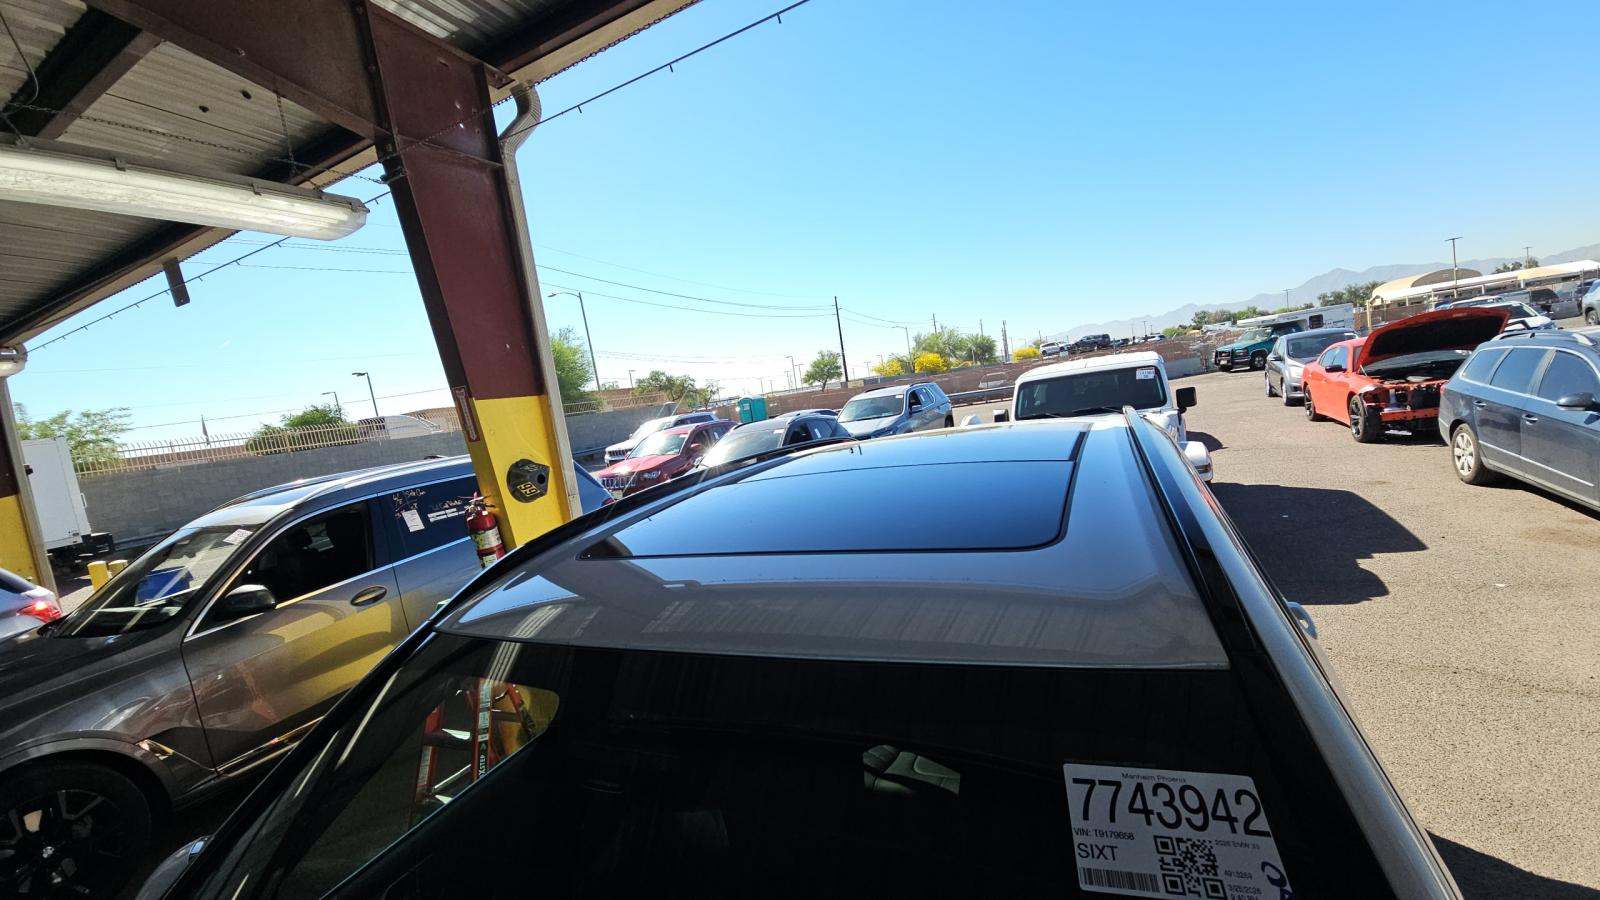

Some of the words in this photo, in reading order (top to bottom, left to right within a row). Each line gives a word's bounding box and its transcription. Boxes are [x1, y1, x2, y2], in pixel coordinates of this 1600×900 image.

[1121, 772, 1156, 782] Manheim
[1156, 774, 1188, 784] Phoenix
[1072, 777, 1271, 838] 7743942
[1073, 827, 1090, 837] VIN:
[1077, 842, 1118, 861] SIXT
